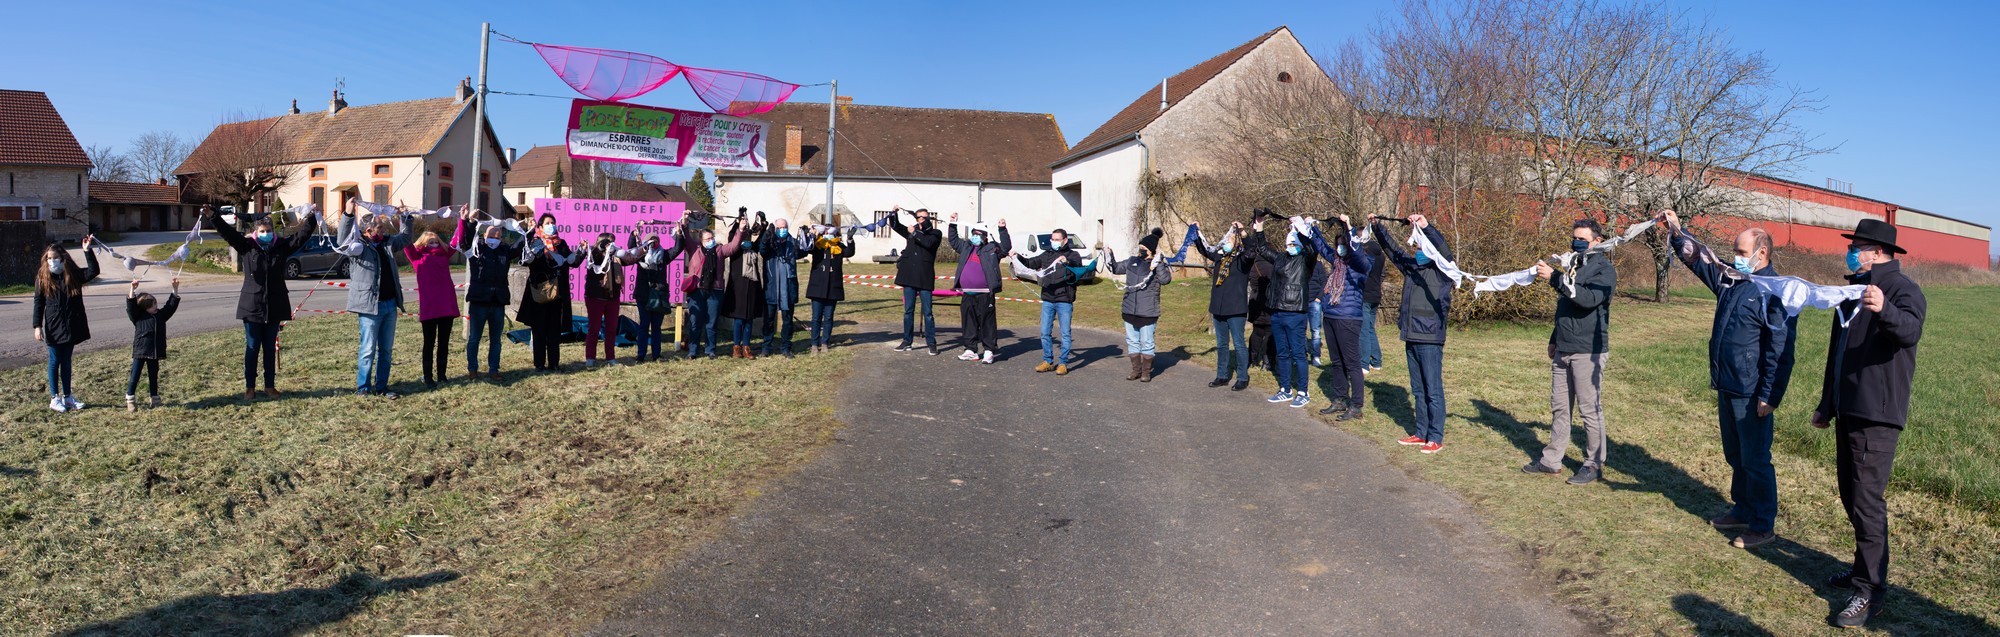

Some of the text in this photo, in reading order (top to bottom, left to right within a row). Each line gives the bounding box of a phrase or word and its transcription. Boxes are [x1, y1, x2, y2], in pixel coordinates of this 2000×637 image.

[679, 112, 761, 133] Marcher pour y croire
[609, 133, 651, 145] ESBARRES
[702, 137, 725, 145] recherche
[580, 140, 616, 150] DIMANCHE
[622, 144, 651, 154] OCTOBRE
[546, 201, 663, 214] LE GRAND DEFI
[578, 224, 631, 234] SOUTIEN
